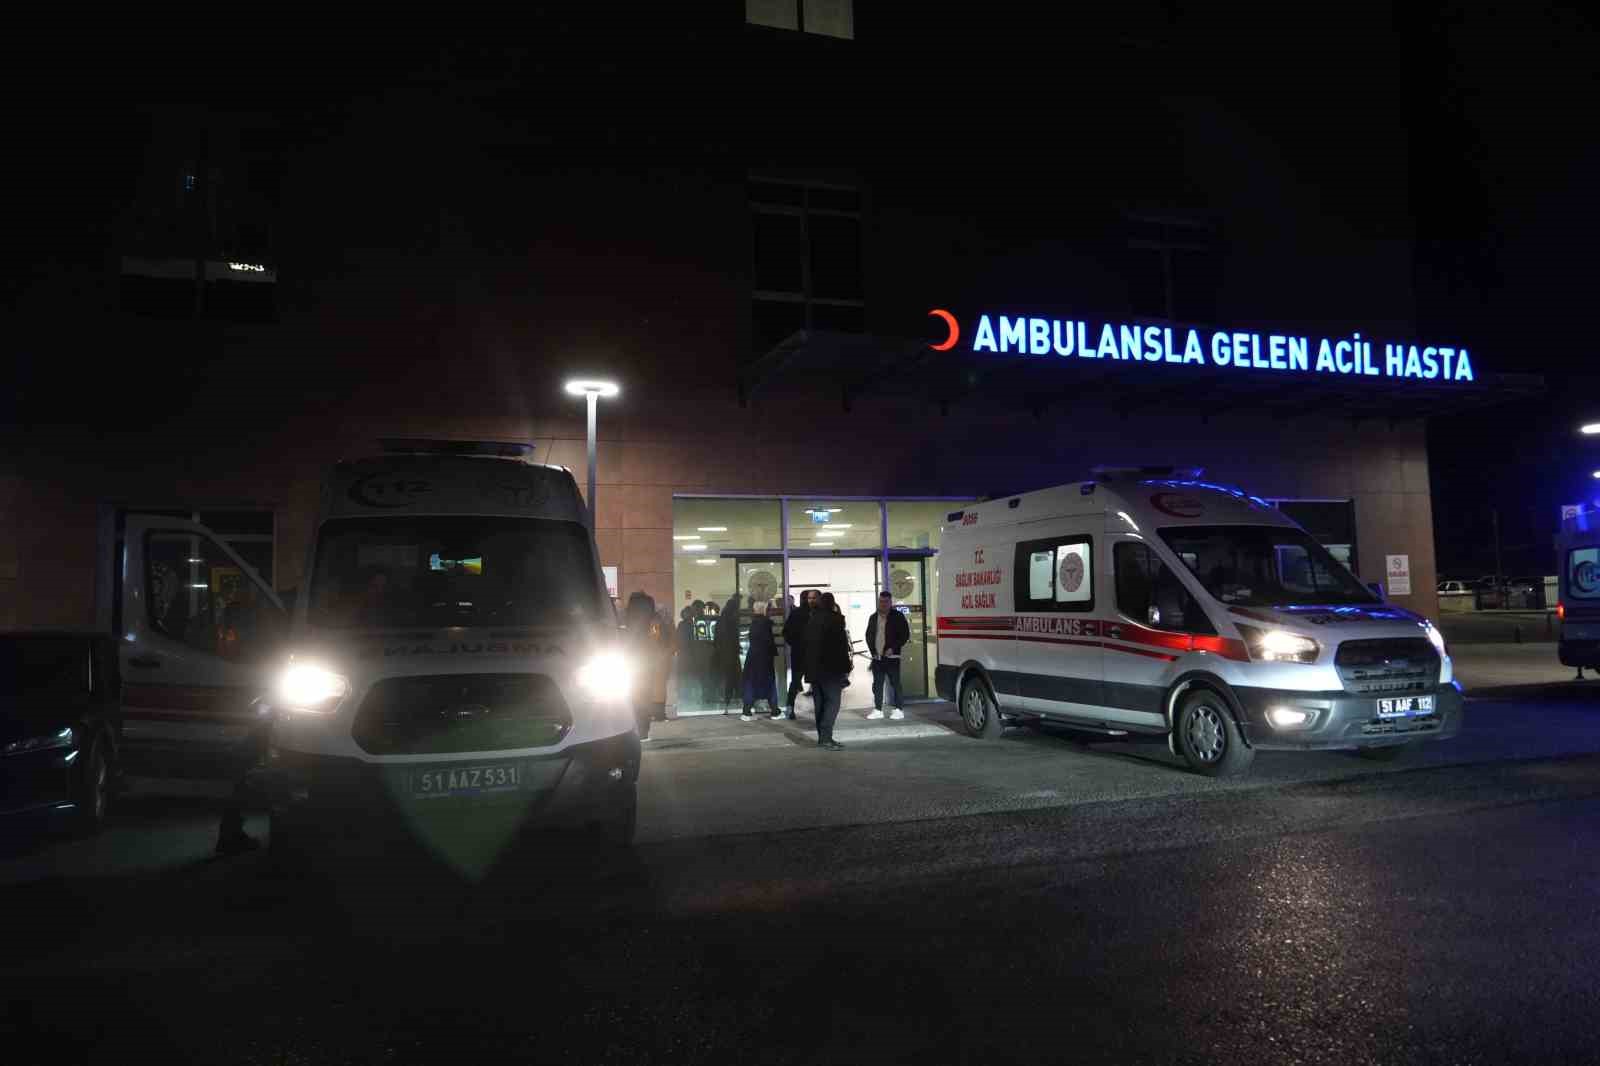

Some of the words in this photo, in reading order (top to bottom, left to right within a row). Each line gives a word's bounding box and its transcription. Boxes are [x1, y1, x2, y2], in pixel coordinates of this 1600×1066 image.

[973, 314, 1205, 365] AMBULANSLA
[1211, 332, 1308, 370] GELEN
[1316, 333, 1379, 375] ACİL
[1385, 344, 1474, 381] HASTA
[1016, 616, 1081, 634] AMBULANS
[1380, 699, 1392, 713] 51
[421, 773, 443, 792] 51
[448, 769, 480, 789] AAZ
[484, 766, 516, 786] 531
